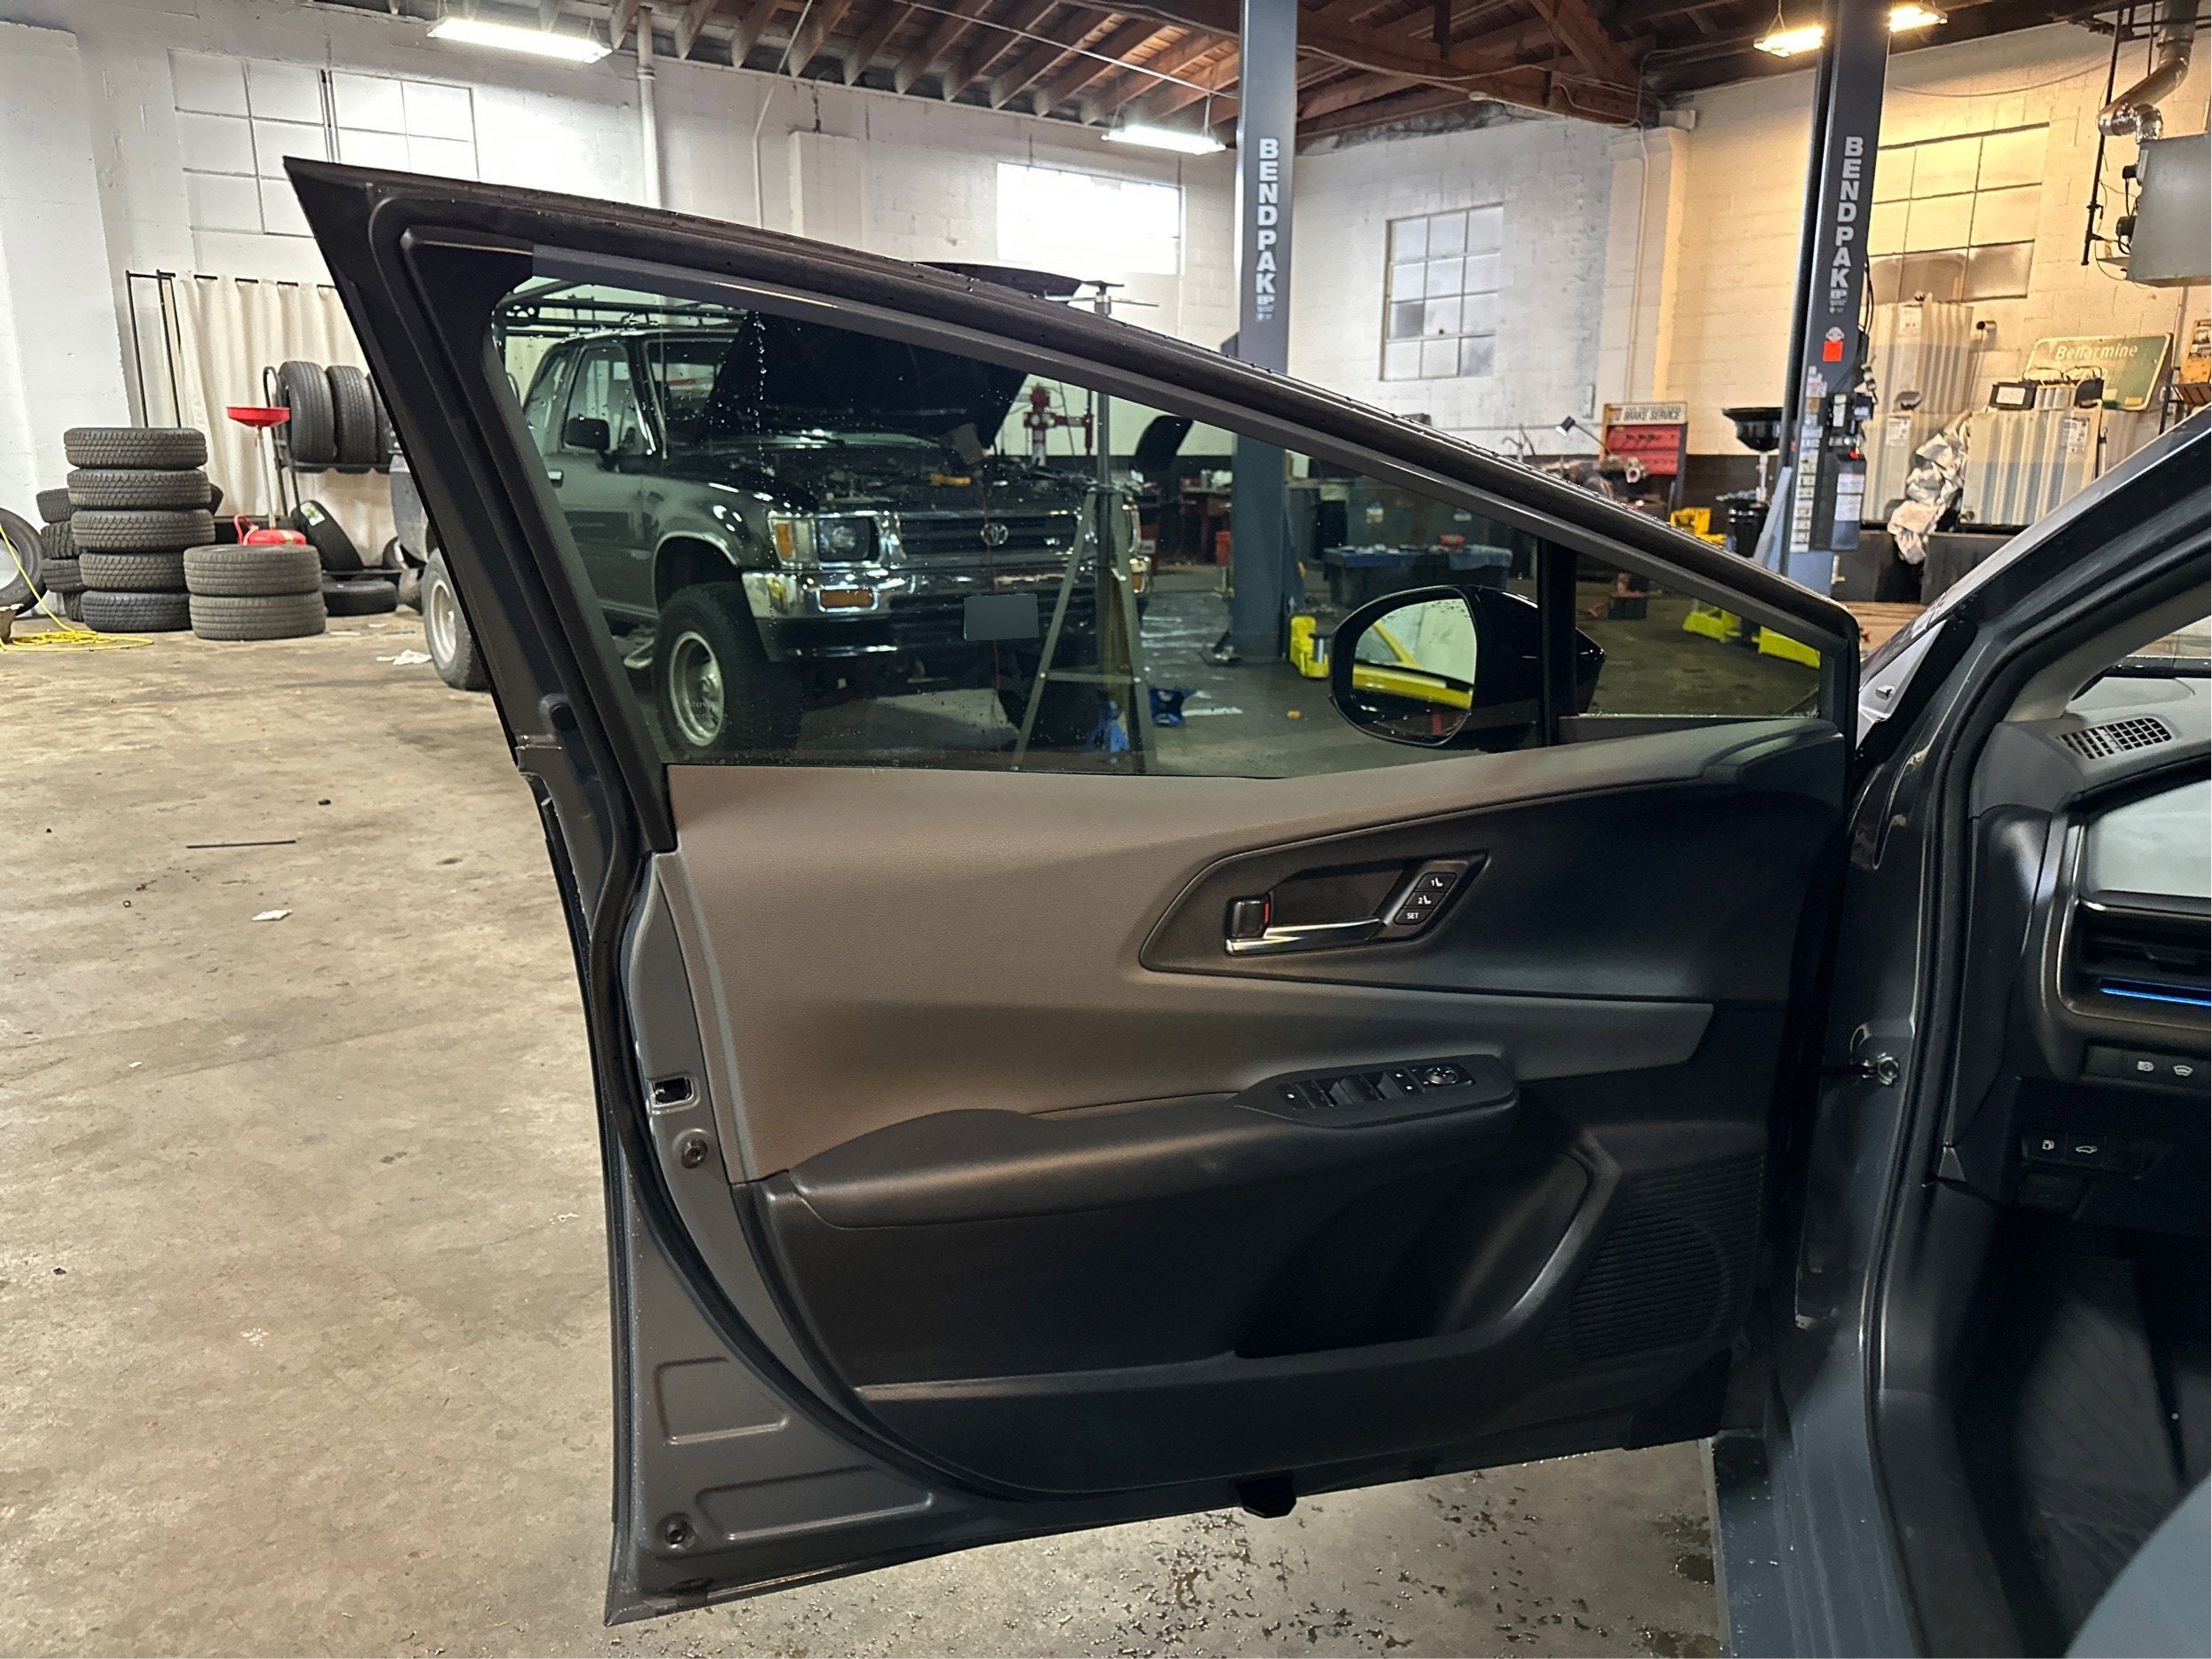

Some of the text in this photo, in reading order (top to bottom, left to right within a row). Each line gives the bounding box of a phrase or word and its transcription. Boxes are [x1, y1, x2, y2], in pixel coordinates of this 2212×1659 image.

[1255, 138, 1278, 293] BENDPAK
[1830, 137, 1864, 287] BENDPAK
[2055, 343, 2138, 361] Bellarmine
